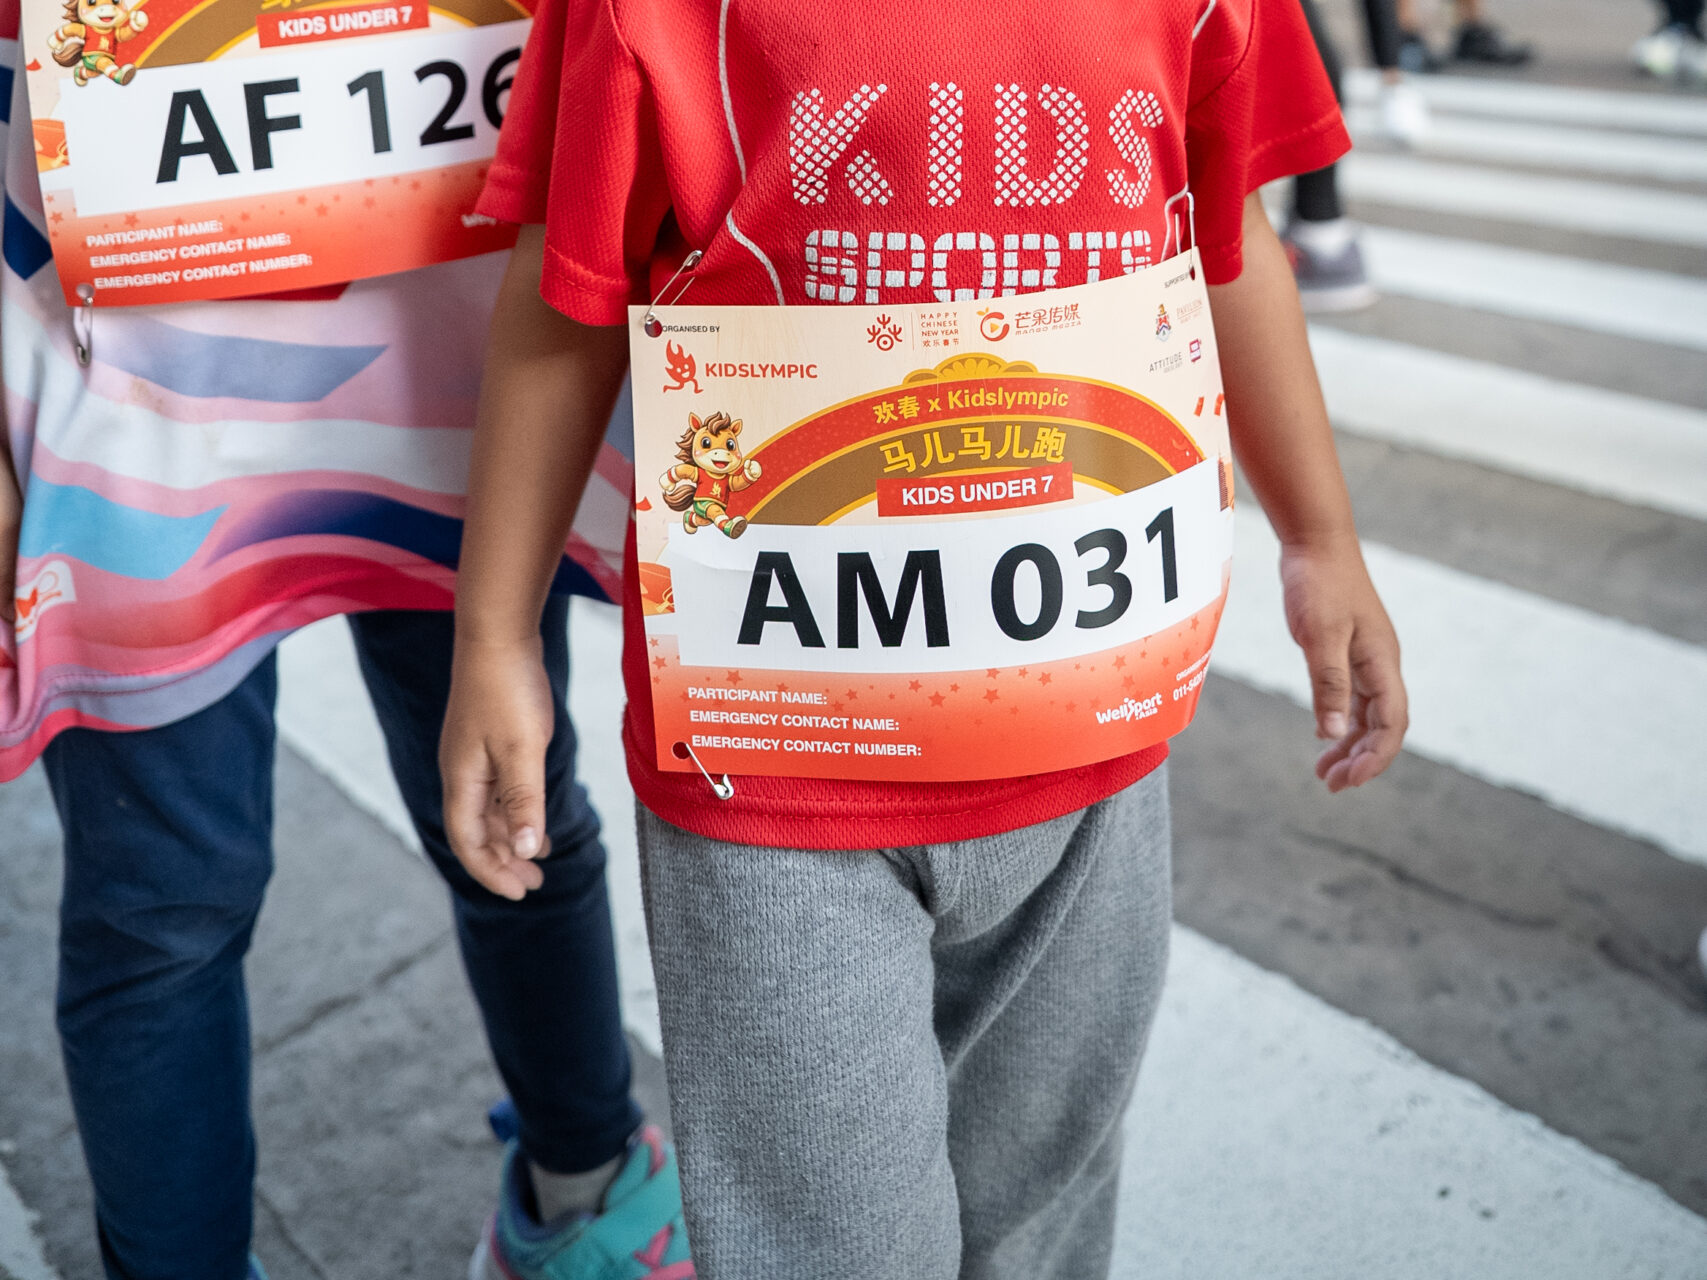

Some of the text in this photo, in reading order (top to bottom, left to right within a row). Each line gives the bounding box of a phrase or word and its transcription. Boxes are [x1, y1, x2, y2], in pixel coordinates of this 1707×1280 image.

[278, 5, 413, 39] KIDS UNDER 7
[155, 45, 523, 184] AF 126
[789, 81, 1164, 209] KIDS
[86, 220, 223, 247] PARTICIPANT NAME:
[90, 233, 291, 268] EMERGENCY CONTACT NAME:
[94, 253, 313, 289] EMERGENCY CONTACT NUMBER:
[920, 311, 958, 320] HAPPY
[920, 319, 958, 328] CHINESE
[1015, 303, 1080, 329] 芒果传媒
[662, 325, 720, 333] ORGANISED BY
[921, 328, 959, 337] NEW YEAR
[705, 362, 818, 379] KIDSLYMPIC
[1149, 352, 1182, 372] ATTITUDE
[872, 387, 1069, 424] 欢春 x Kidslympic
[879, 424, 1067, 473] 马儿马儿跑
[902, 475, 1054, 506] KIDS UNDER 7
[737, 506, 1179, 649] AM 031
[688, 687, 828, 705] PARTICIPANT NAME:
[690, 710, 900, 731] EMERGENCY CONTACT NAME:
[692, 734, 922, 757] EMERGENCY CONTACT NUMBER:
